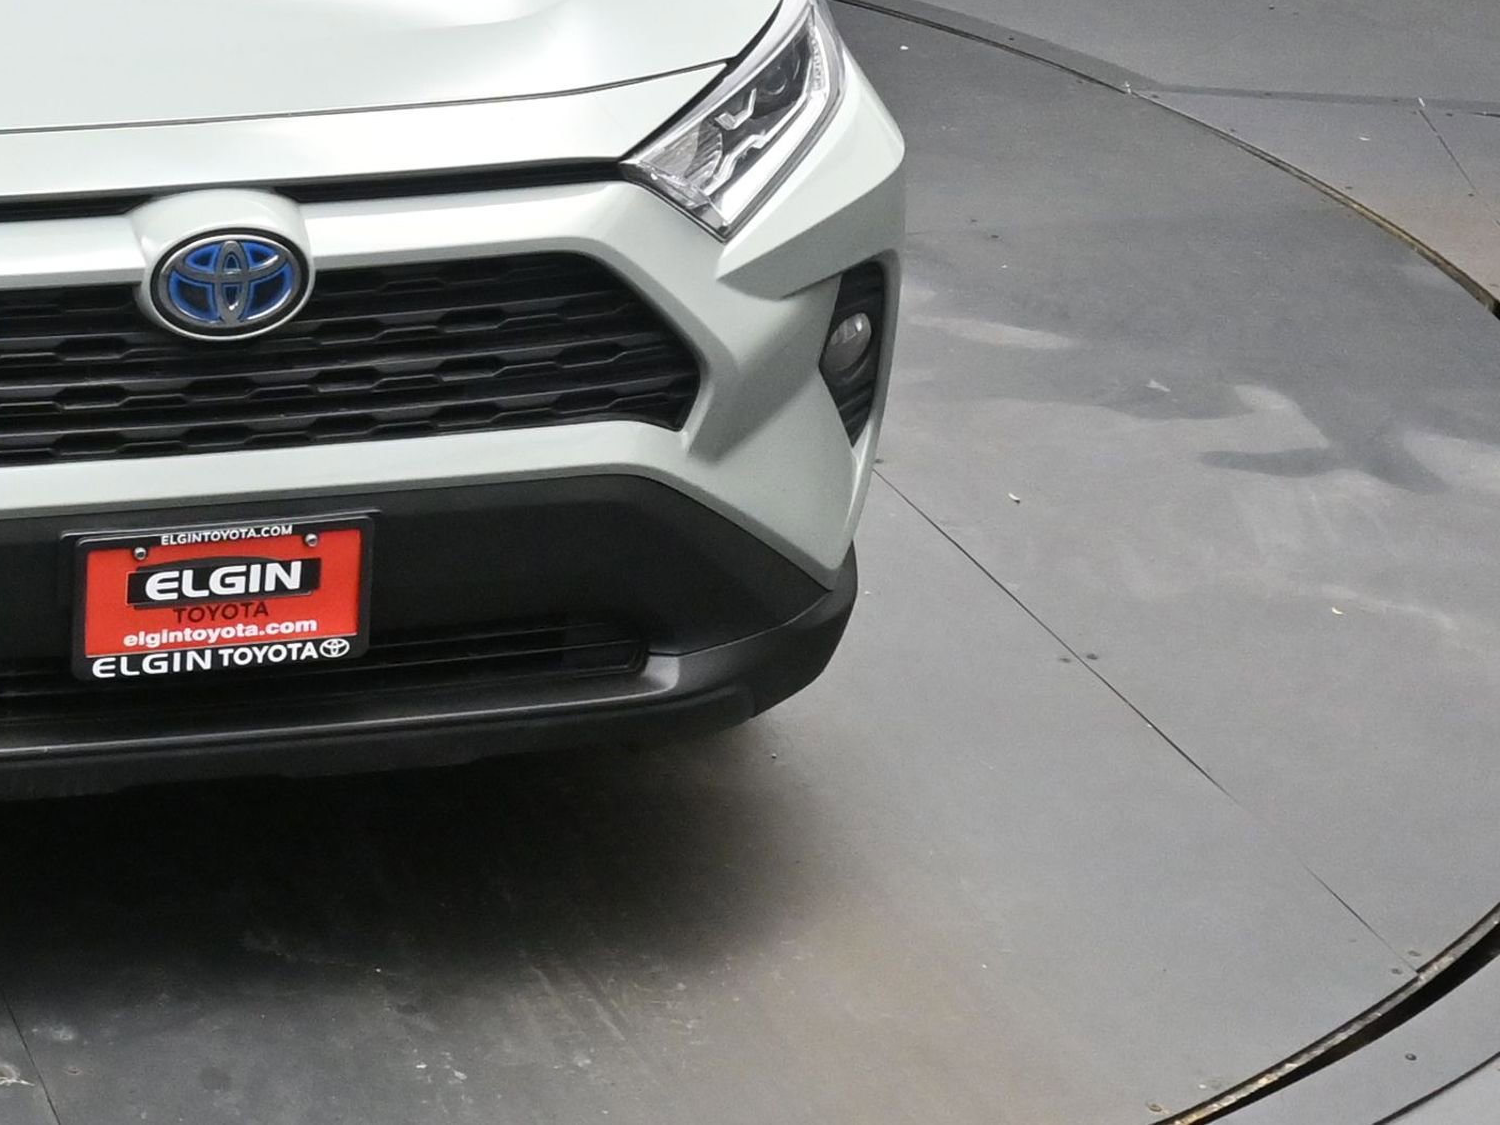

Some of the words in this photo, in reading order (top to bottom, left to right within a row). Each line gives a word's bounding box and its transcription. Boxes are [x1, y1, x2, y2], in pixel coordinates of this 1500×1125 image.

[160, 525, 293, 546] ELGINTOYOTA.COM
[145, 560, 302, 601] ELGIN
[173, 601, 269, 624] TOYOTA
[123, 619, 318, 648] elgintoyota.com
[92, 649, 212, 678] ELGIN
[218, 641, 319, 667] TOYOTA
